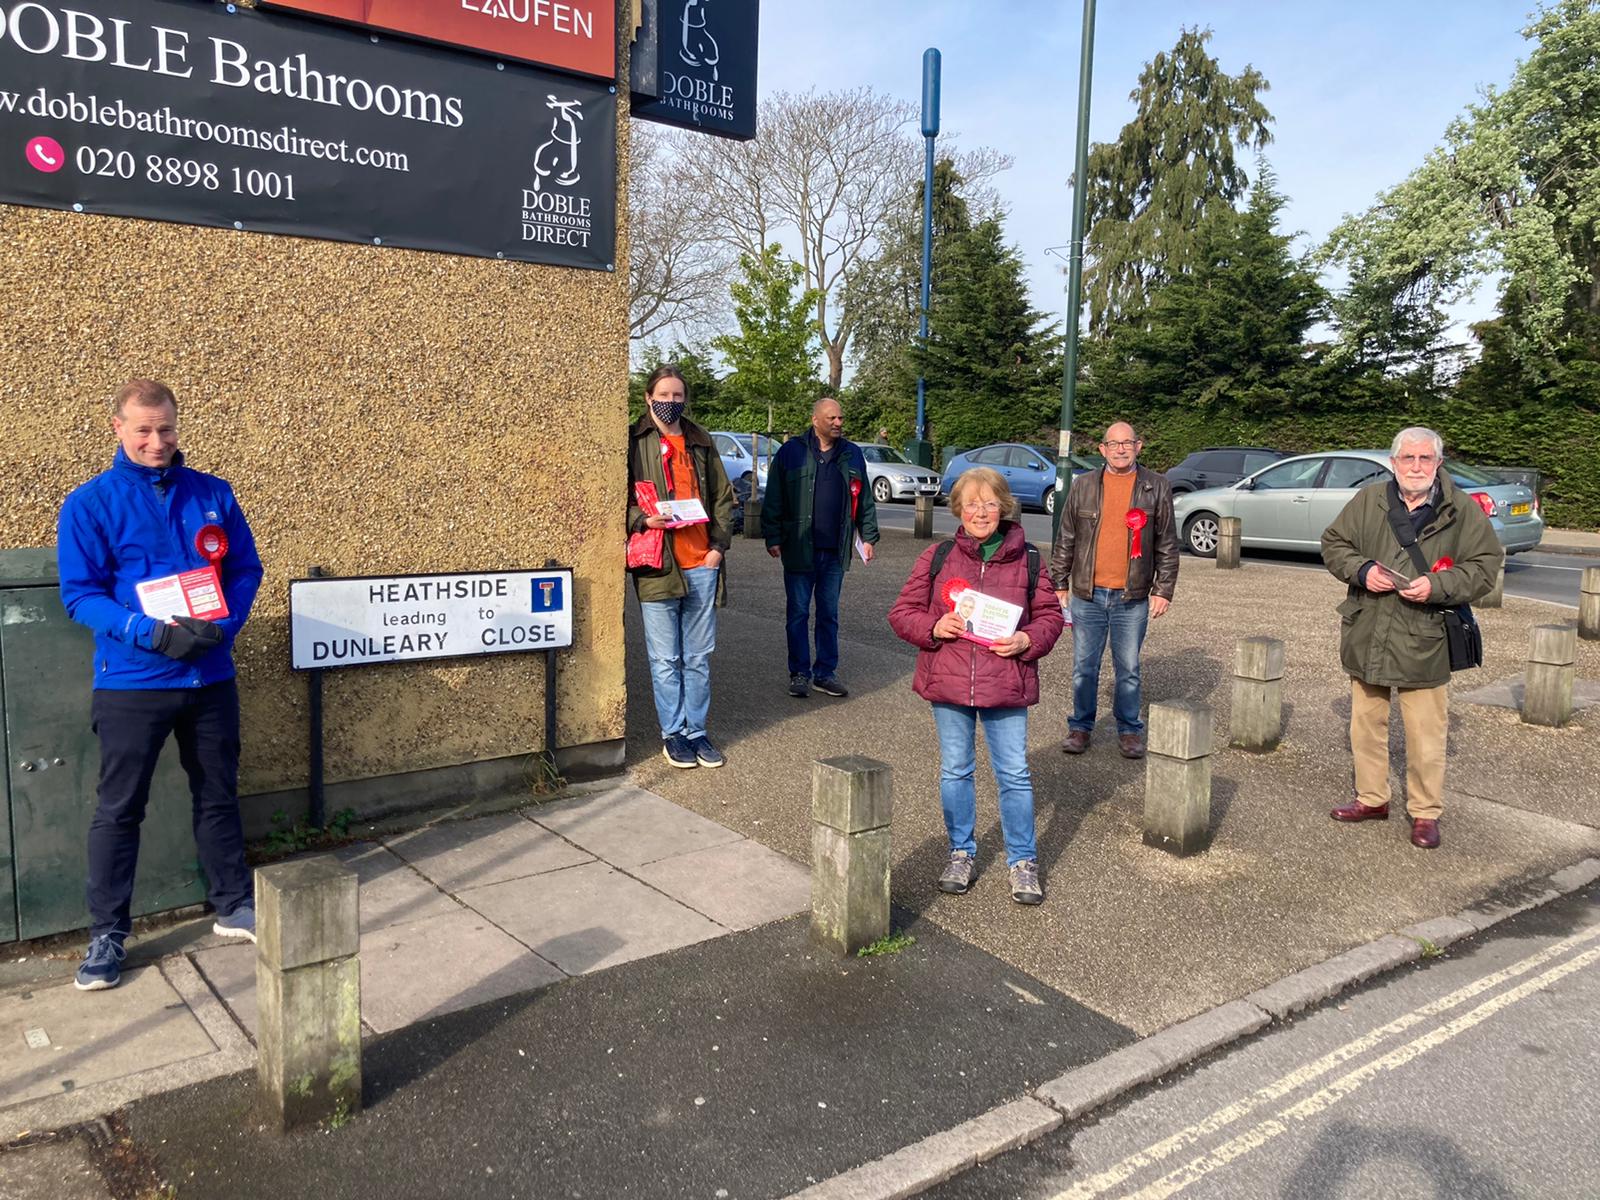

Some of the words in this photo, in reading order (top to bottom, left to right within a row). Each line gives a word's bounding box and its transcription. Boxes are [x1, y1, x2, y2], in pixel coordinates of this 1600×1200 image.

[0, 2, 193, 79] OBLE
[208, 36, 464, 127] Bathrooms
[76, 145, 136, 179] 020
[146, 154, 220, 191] 8898
[232, 166, 296, 201] 1001
[522, 189, 591, 217] DOBLE
[522, 210, 591, 228] BATHROOMS
[522, 223, 591, 248] DIRECT
[369, 579, 507, 603] HEATHSIDE
[384, 611, 446, 627] leading
[478, 607, 494, 620] to
[313, 631, 448, 661] DUNLEARY
[481, 624, 556, 646] CLOSE
